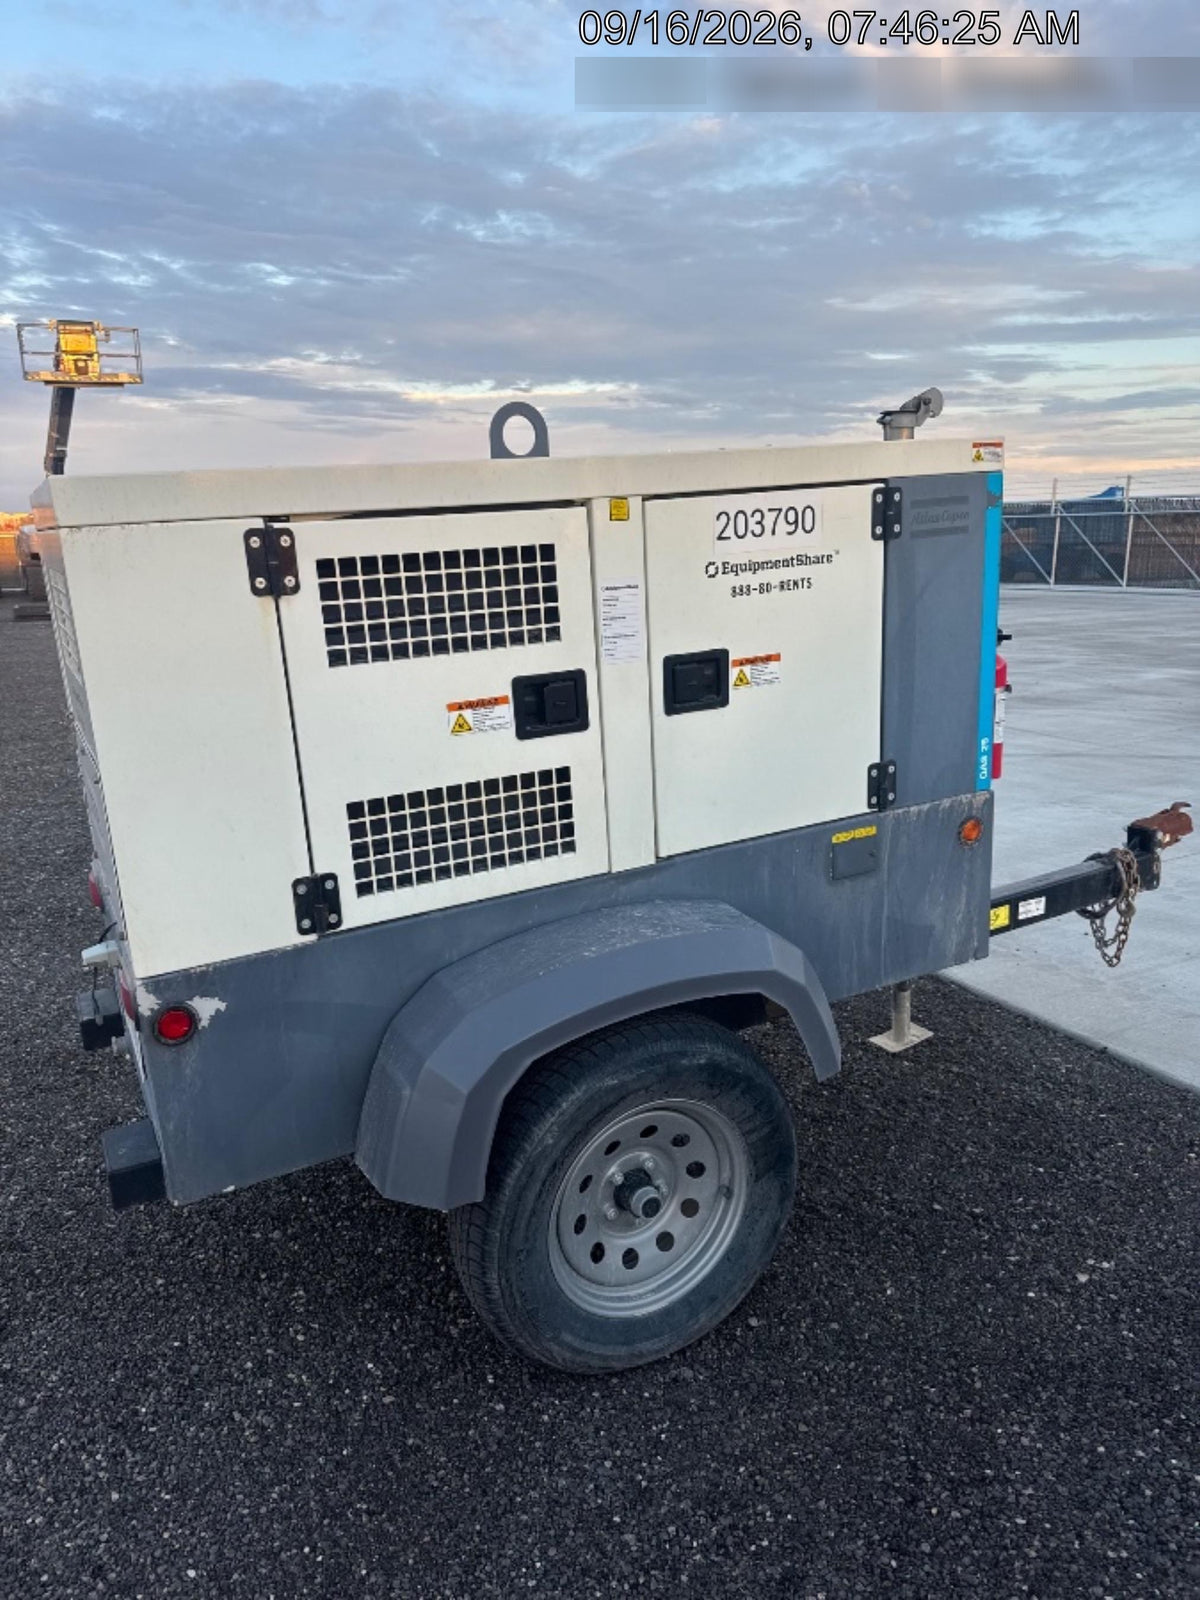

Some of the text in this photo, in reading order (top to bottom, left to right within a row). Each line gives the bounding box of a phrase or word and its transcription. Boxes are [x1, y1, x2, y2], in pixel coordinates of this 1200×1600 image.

[715, 505, 816, 541] 203790
[721, 553, 834, 577] EquipmentShare
[730, 577, 813, 599] 888-80-RENTS
